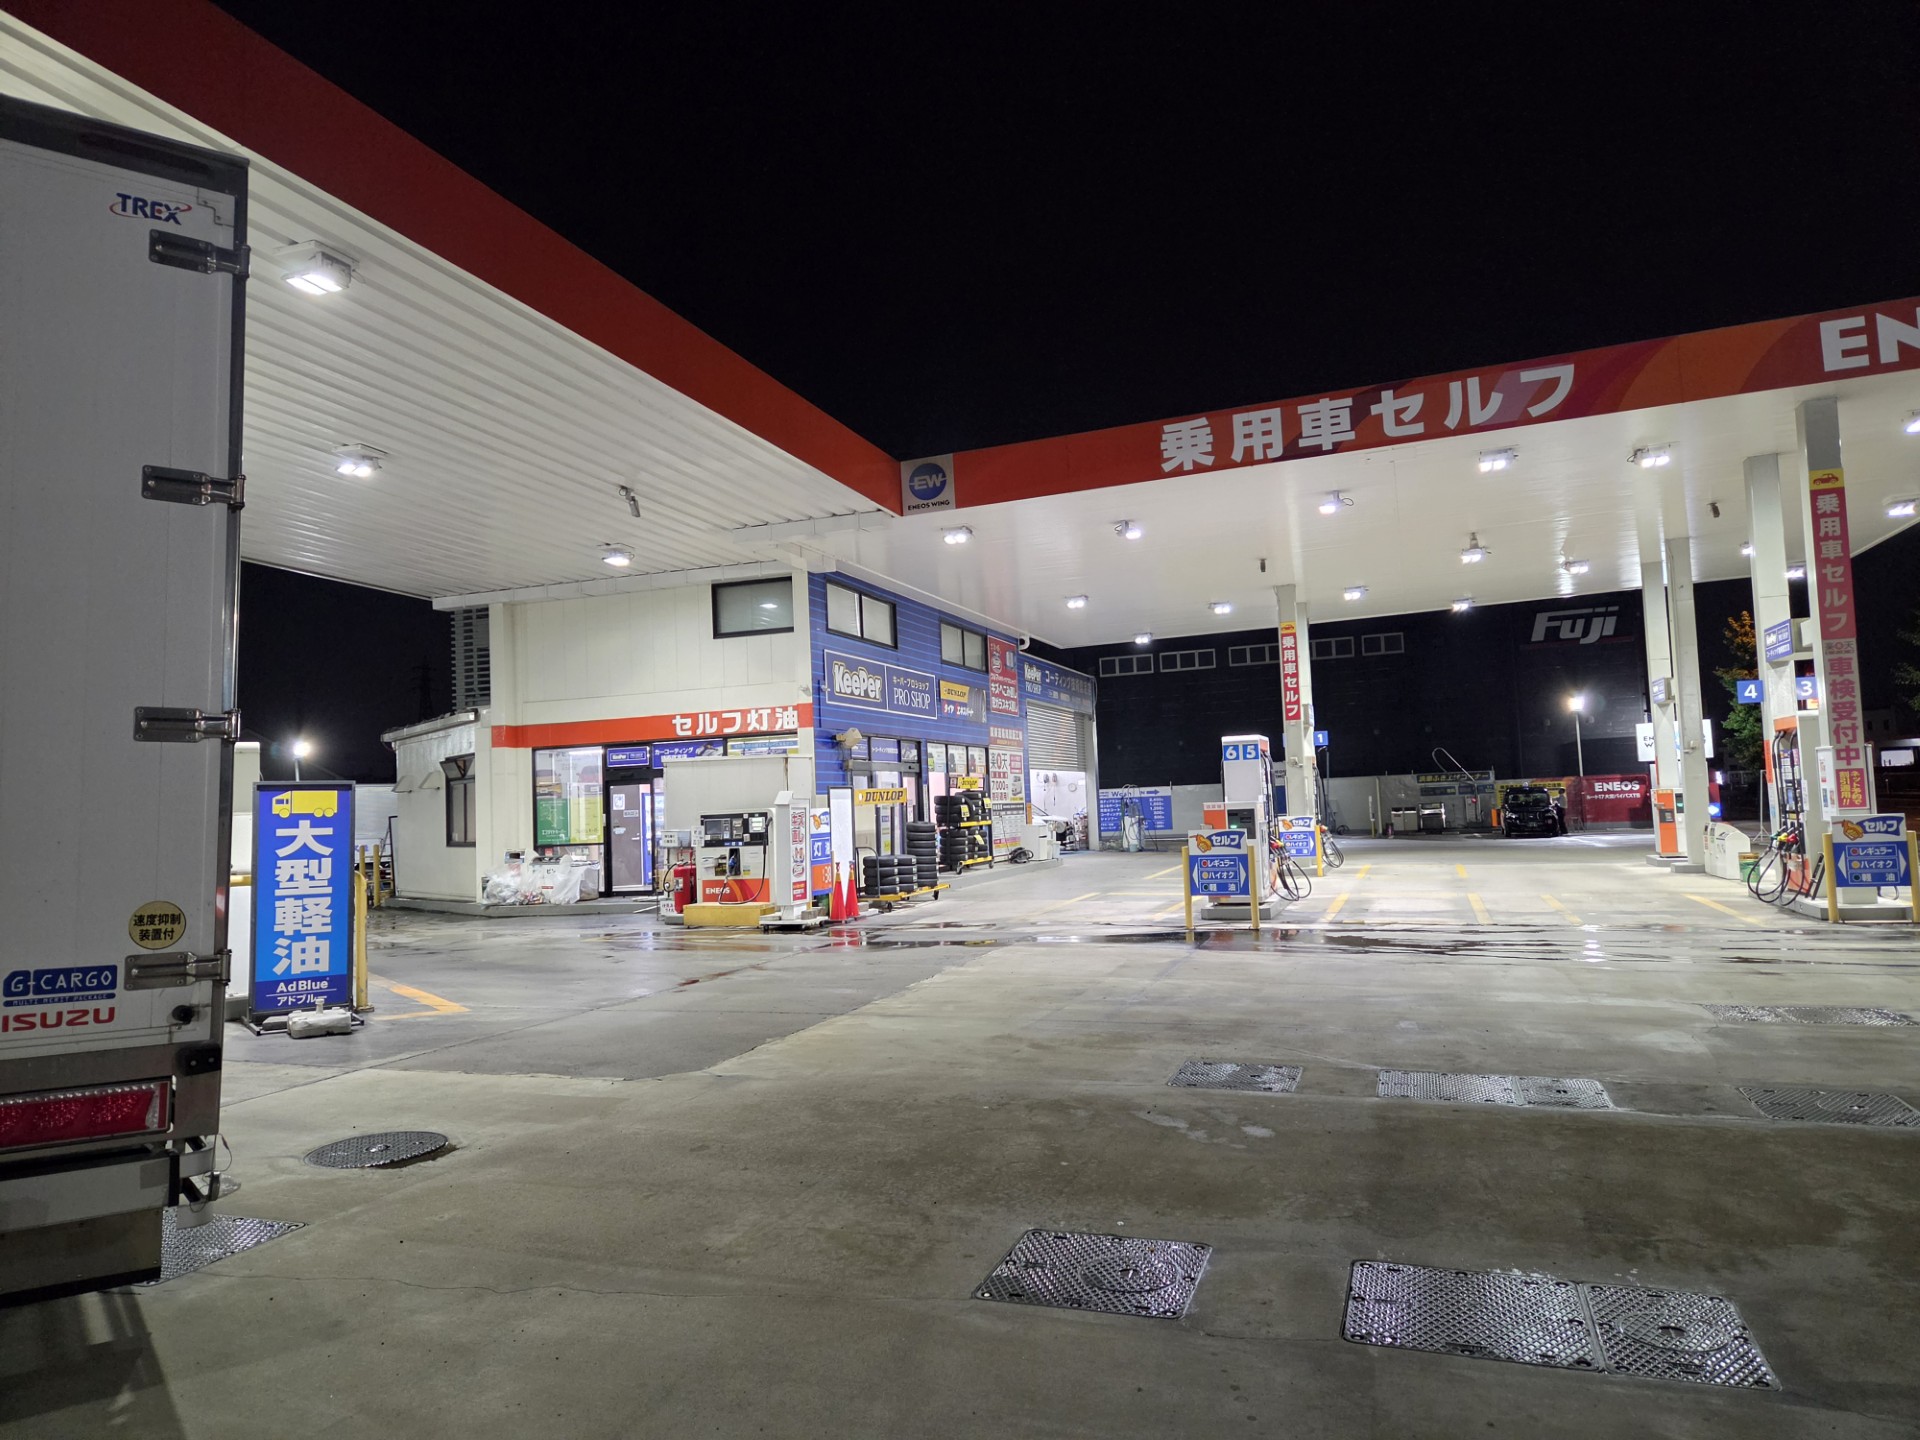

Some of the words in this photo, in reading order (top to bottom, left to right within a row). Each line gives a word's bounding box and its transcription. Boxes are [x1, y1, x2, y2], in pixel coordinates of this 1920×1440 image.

[116, 193, 182, 225] TREX
[1160, 364, 1575, 473] 乗用車セルフ
[908, 503, 930, 511] ENEOS
[1816, 493, 1848, 632] 乗用車セルフ
[1530, 606, 1619, 645] Fuji
[833, 660, 882, 701] KeePer
[892, 675, 929, 690] キーパープロショップ
[1281, 636, 1299, 718] 乗用車セルフ
[947, 688, 967, 698] DUNLOP
[1744, 684, 1758, 699] 4
[1801, 681, 1813, 696] 3
[894, 690, 910, 706] PRO
[911, 692, 931, 709] SHOP
[1827, 657, 1860, 766] 車検受付中
[672, 706, 799, 736] セルフ灯油
[1317, 734, 1324, 743] 1
[654, 747, 693, 755] カーコーティング
[1226, 745, 1237, 760] 6
[1246, 745, 1256, 760] 5
[1594, 781, 1640, 792] ENEOS
[864, 790, 904, 803] DUNLOP
[1292, 818, 1310, 827] セルフ
[1863, 820, 1898, 832] セルフ
[1211, 835, 1239, 846] セルフ
[1859, 847, 1892, 856] レギュラー
[1861, 861, 1893, 869] ハイオク
[1861, 873, 1895, 882] 軽油
[1209, 883, 1236, 891] 軽油
[272, 819, 334, 976] 大型軽油
[133, 913, 181, 926] 速度抑制
[138, 928, 175, 941] 装置付
[13, 998, 38, 1006] MULTI
[74, 993, 108, 1001] PACKAGE
[277, 993, 327, 1006] アドブルー
[2, 1007, 115, 1032] ISUZU
